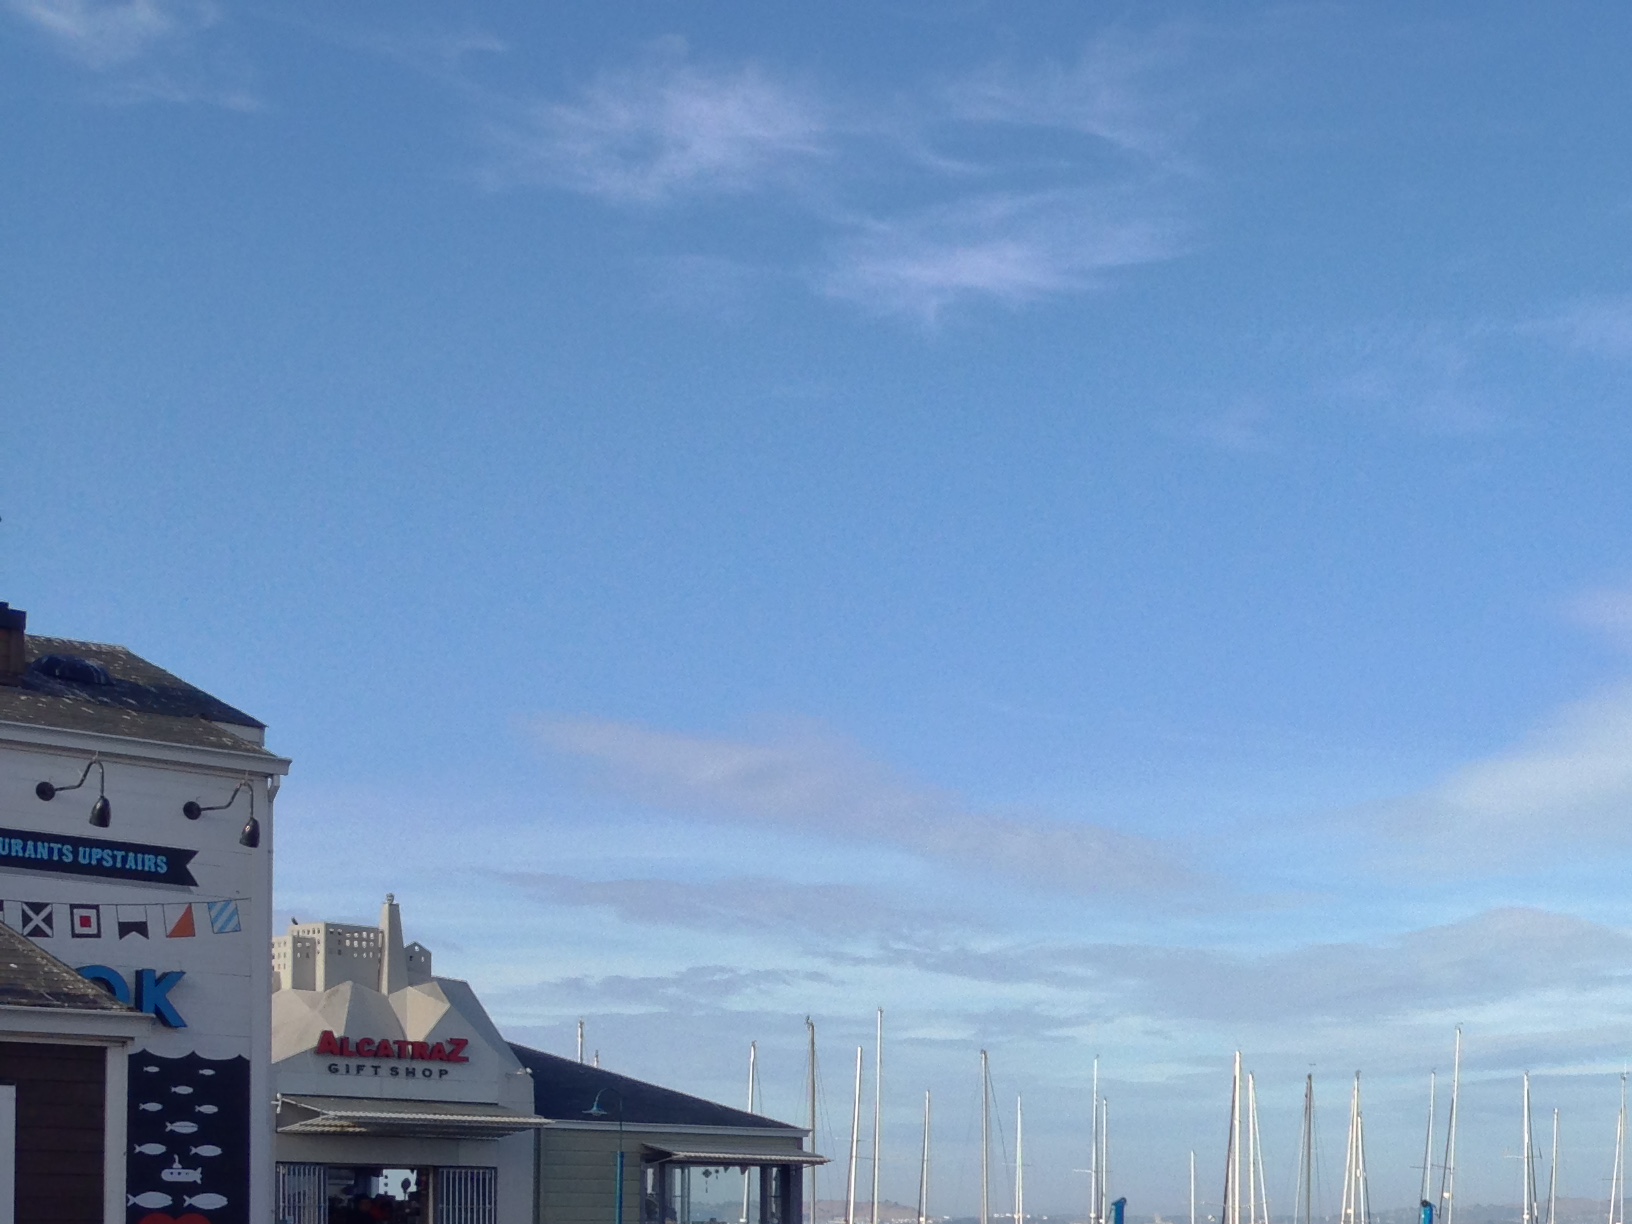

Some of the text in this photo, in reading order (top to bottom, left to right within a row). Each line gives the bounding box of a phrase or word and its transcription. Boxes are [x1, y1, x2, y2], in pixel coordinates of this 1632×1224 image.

[78, 846, 168, 874] UPSTAIRS
[314, 1030, 470, 1064] ALCATRAZ
[327, 1062, 449, 1079] GIFT SHOP
